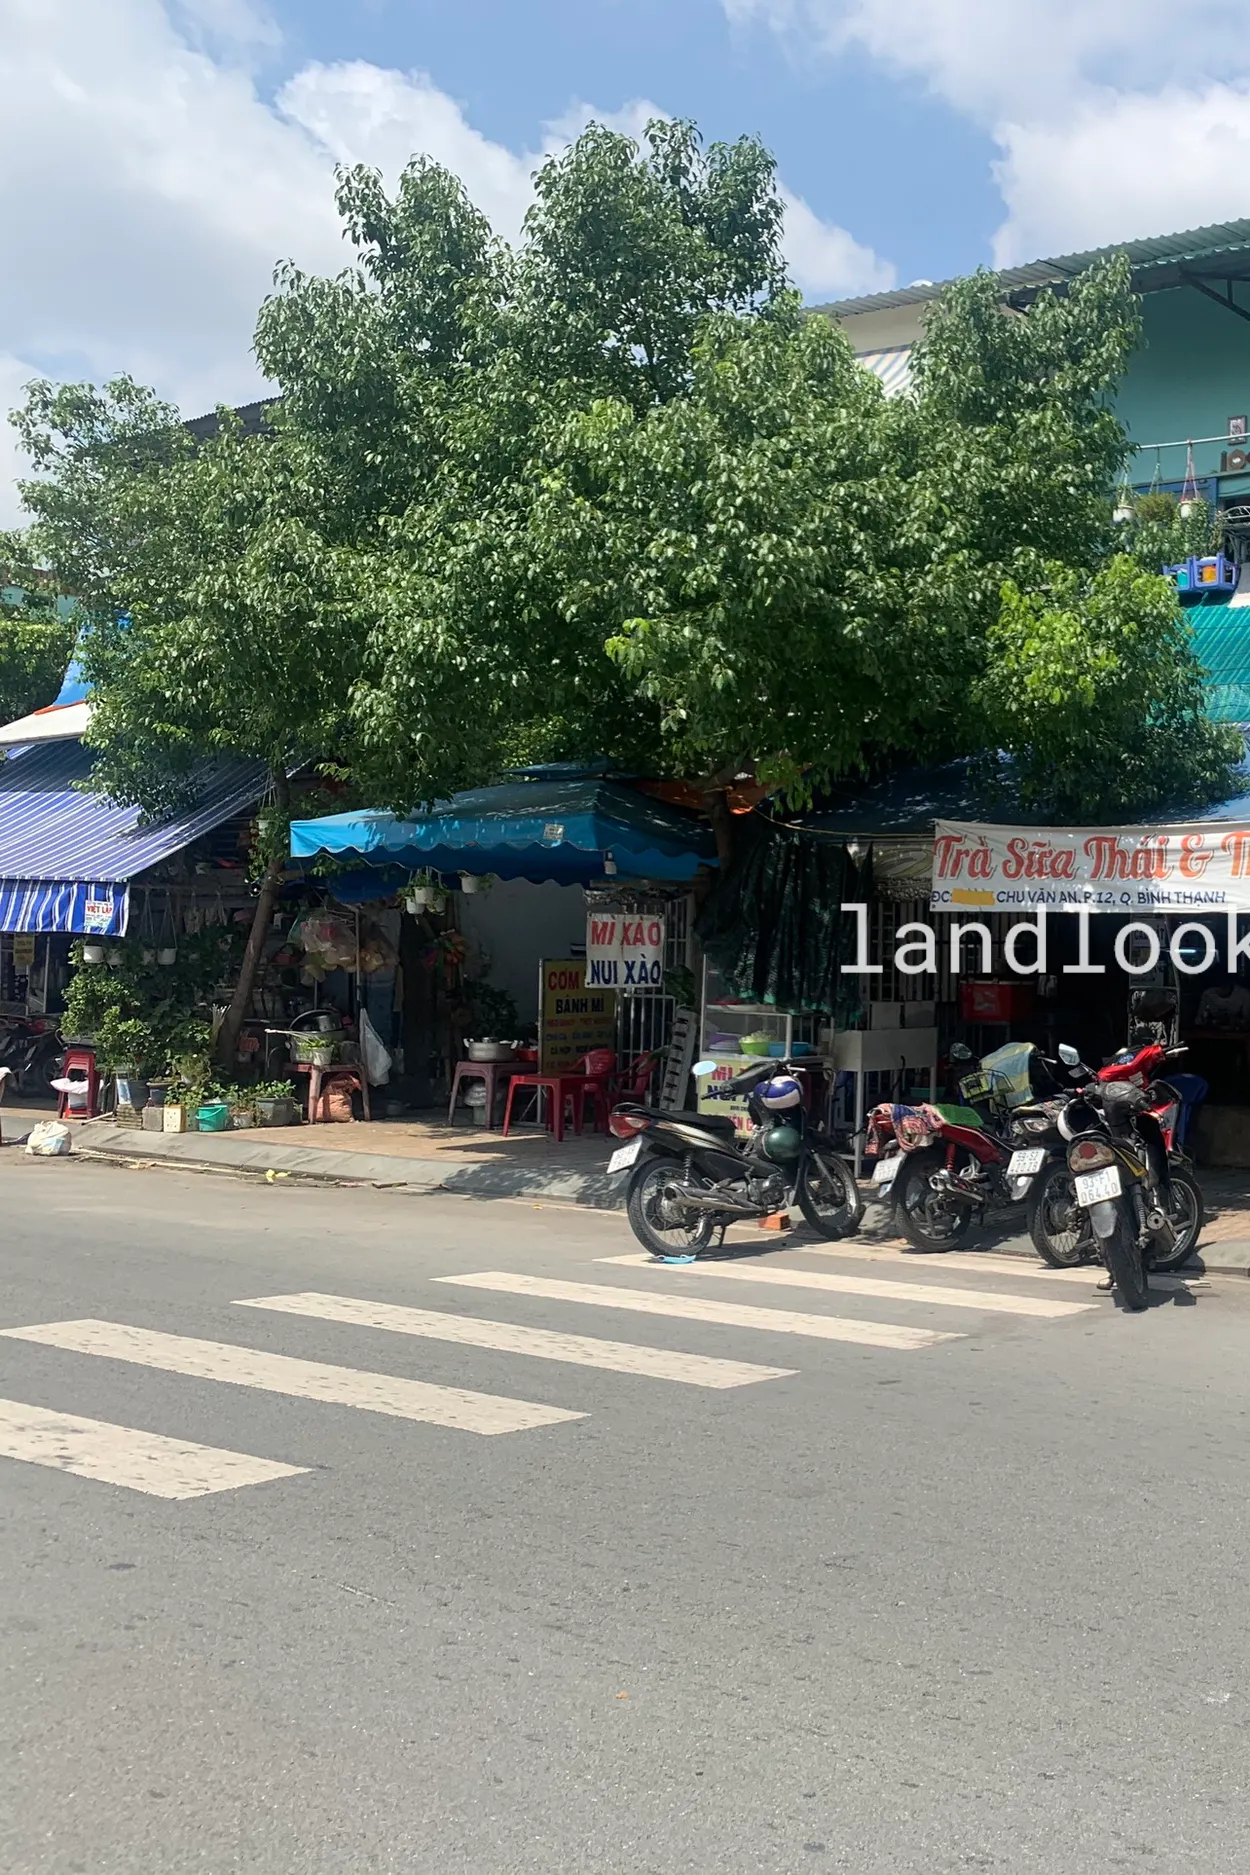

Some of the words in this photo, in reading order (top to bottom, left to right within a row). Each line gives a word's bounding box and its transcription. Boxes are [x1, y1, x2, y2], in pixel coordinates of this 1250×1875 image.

[933, 835, 997, 880] Trà
[1002, 836, 1079, 880] Sữa
[1083, 834, 1174, 881] Thái
[1179, 832, 1214, 880] &
[996, 890, 1024, 903] CHU
[1028, 887, 1056, 903] VĂN
[1138, 888, 1171, 904] BÌNH
[1173, 891, 1226, 907] THẠNH
[591, 914, 617, 946] MÌ
[621, 916, 662, 947] XÀO
[590, 960, 618, 985] NUI
[624, 953, 662, 985] XÀO
